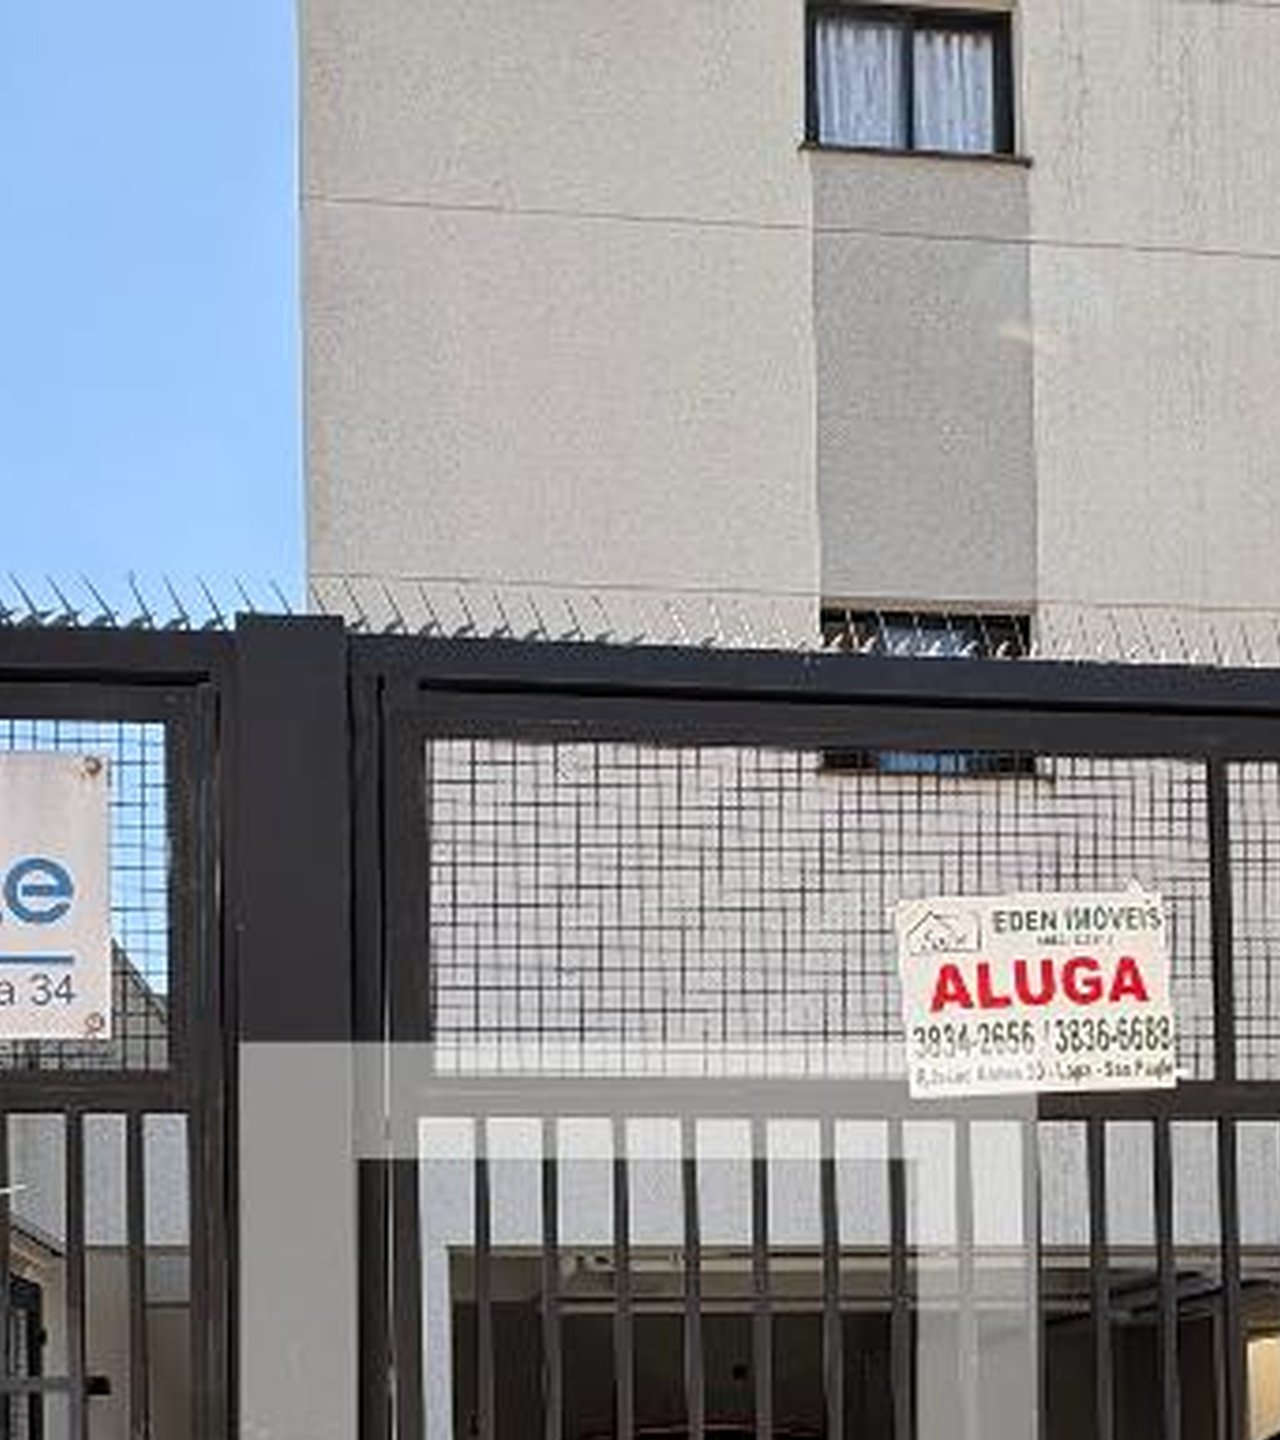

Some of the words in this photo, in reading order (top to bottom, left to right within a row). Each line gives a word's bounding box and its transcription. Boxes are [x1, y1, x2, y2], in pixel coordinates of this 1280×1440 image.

[993, 909, 1058, 934] EDEN
[28, 973, 77, 1006] 34
[929, 955, 1151, 1013] ALUGA
